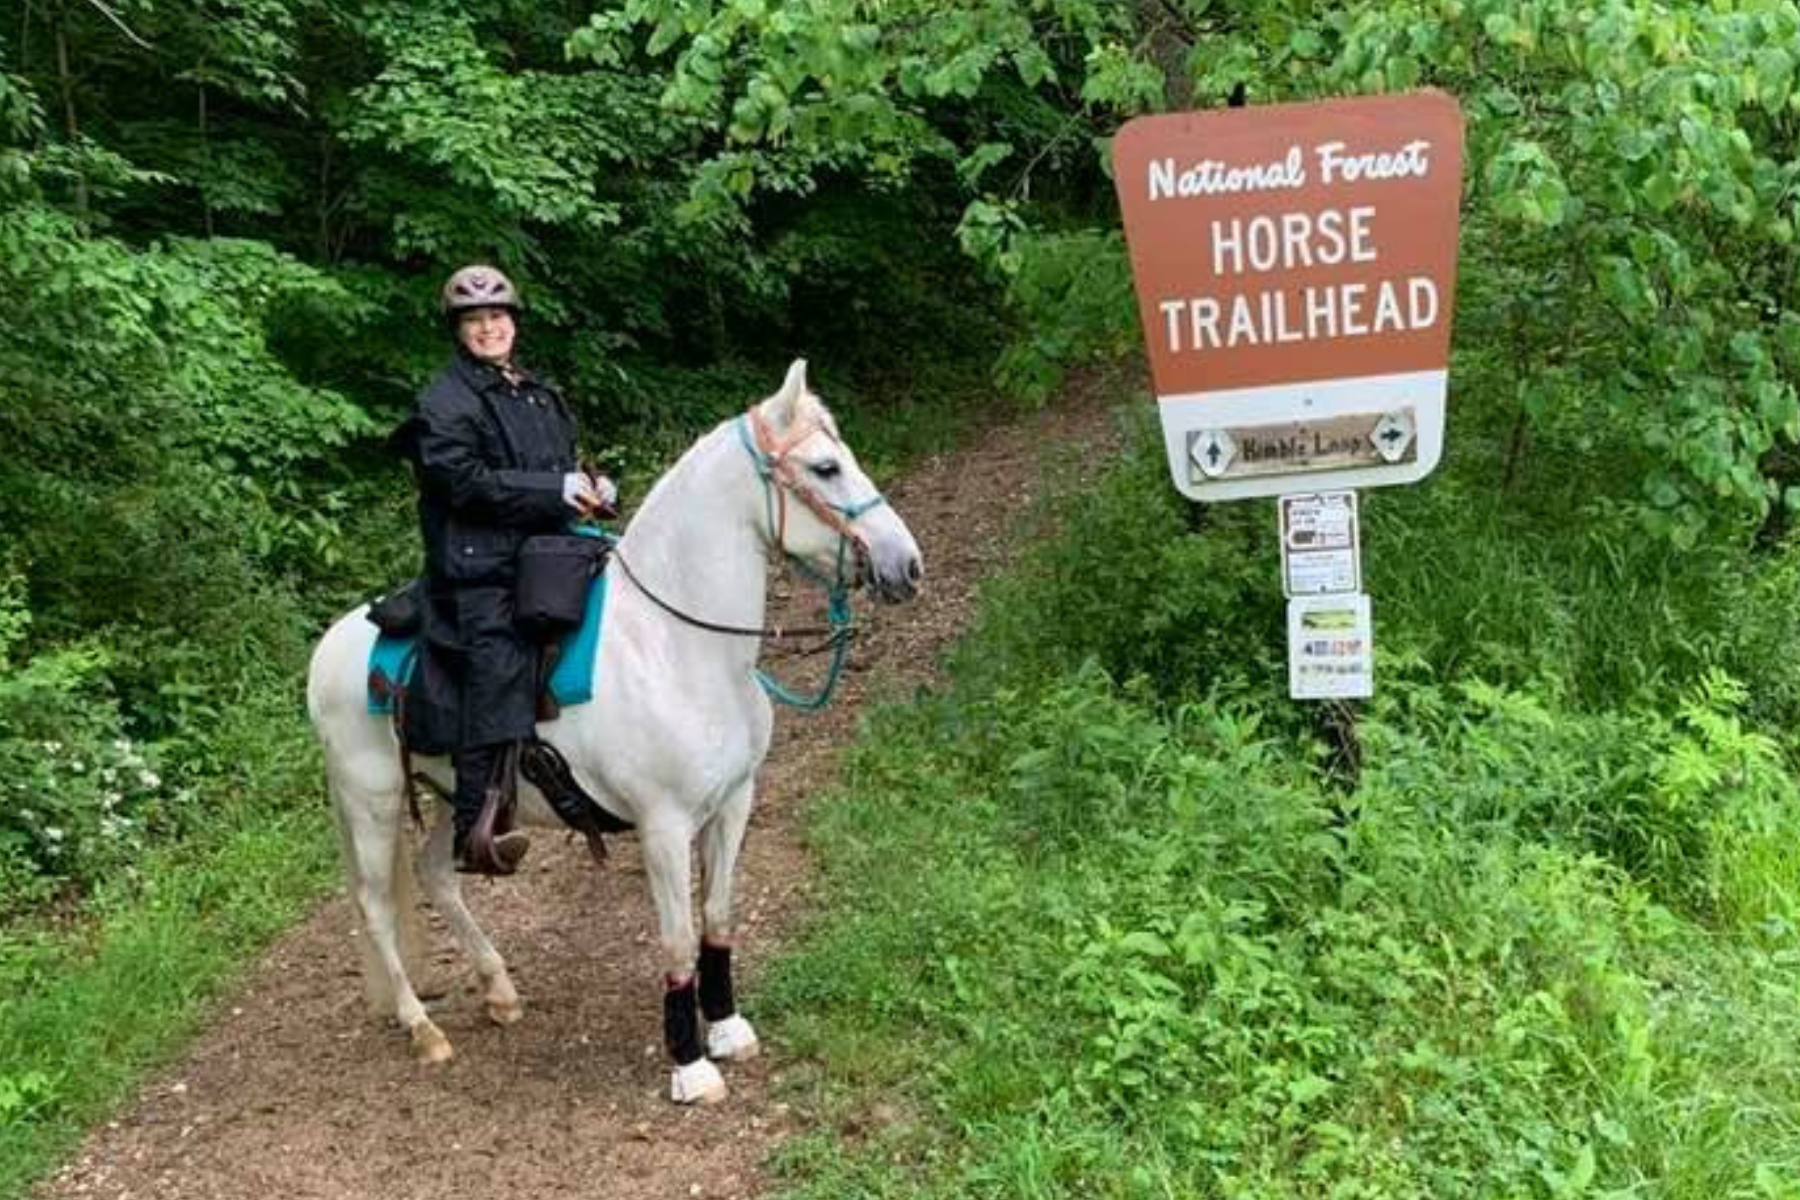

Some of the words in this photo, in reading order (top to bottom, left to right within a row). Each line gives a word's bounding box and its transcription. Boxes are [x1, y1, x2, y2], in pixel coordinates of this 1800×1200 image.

[1149, 147, 1305, 200] National
[1314, 141, 1430, 184] Forest
[1211, 206, 1377, 275] HORSE
[1159, 277, 1439, 352] TRAILHEAD
